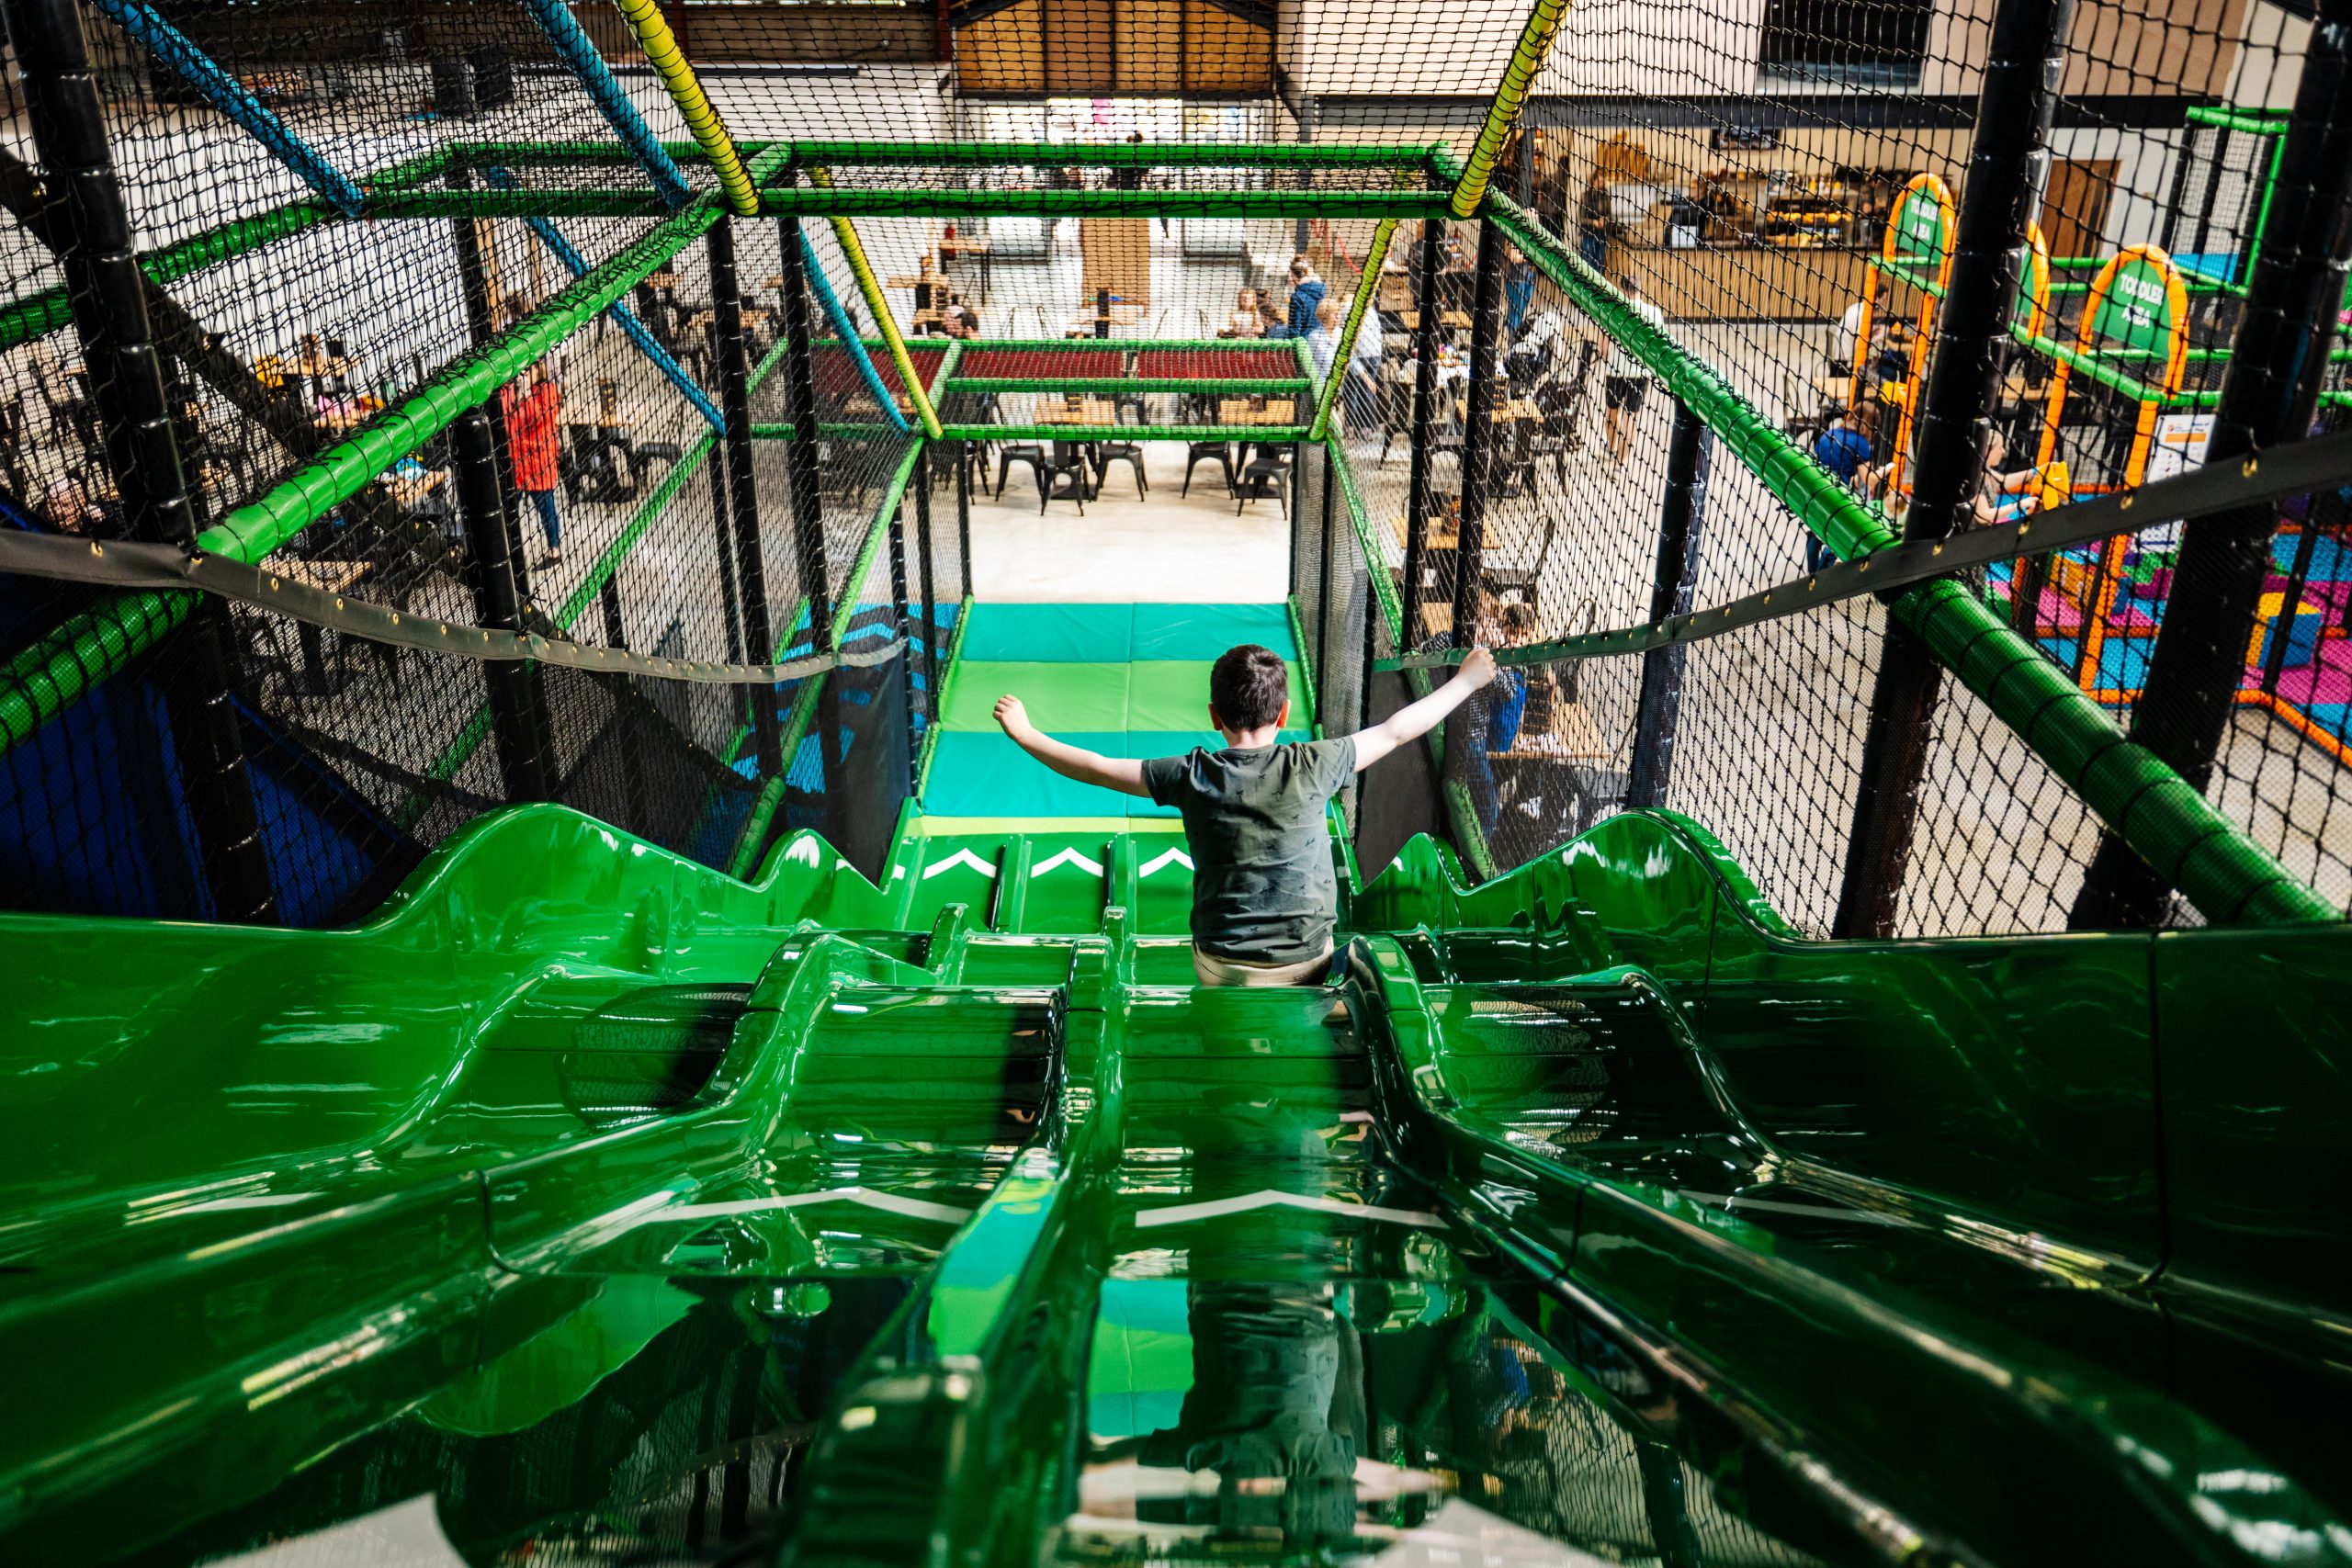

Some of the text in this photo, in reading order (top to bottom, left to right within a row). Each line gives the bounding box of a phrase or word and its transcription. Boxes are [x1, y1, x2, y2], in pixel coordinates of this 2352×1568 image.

[1911, 197, 1939, 221] TODDLER
[2120, 273, 2164, 307] TODDLER
[2121, 302, 2150, 329] AREA
